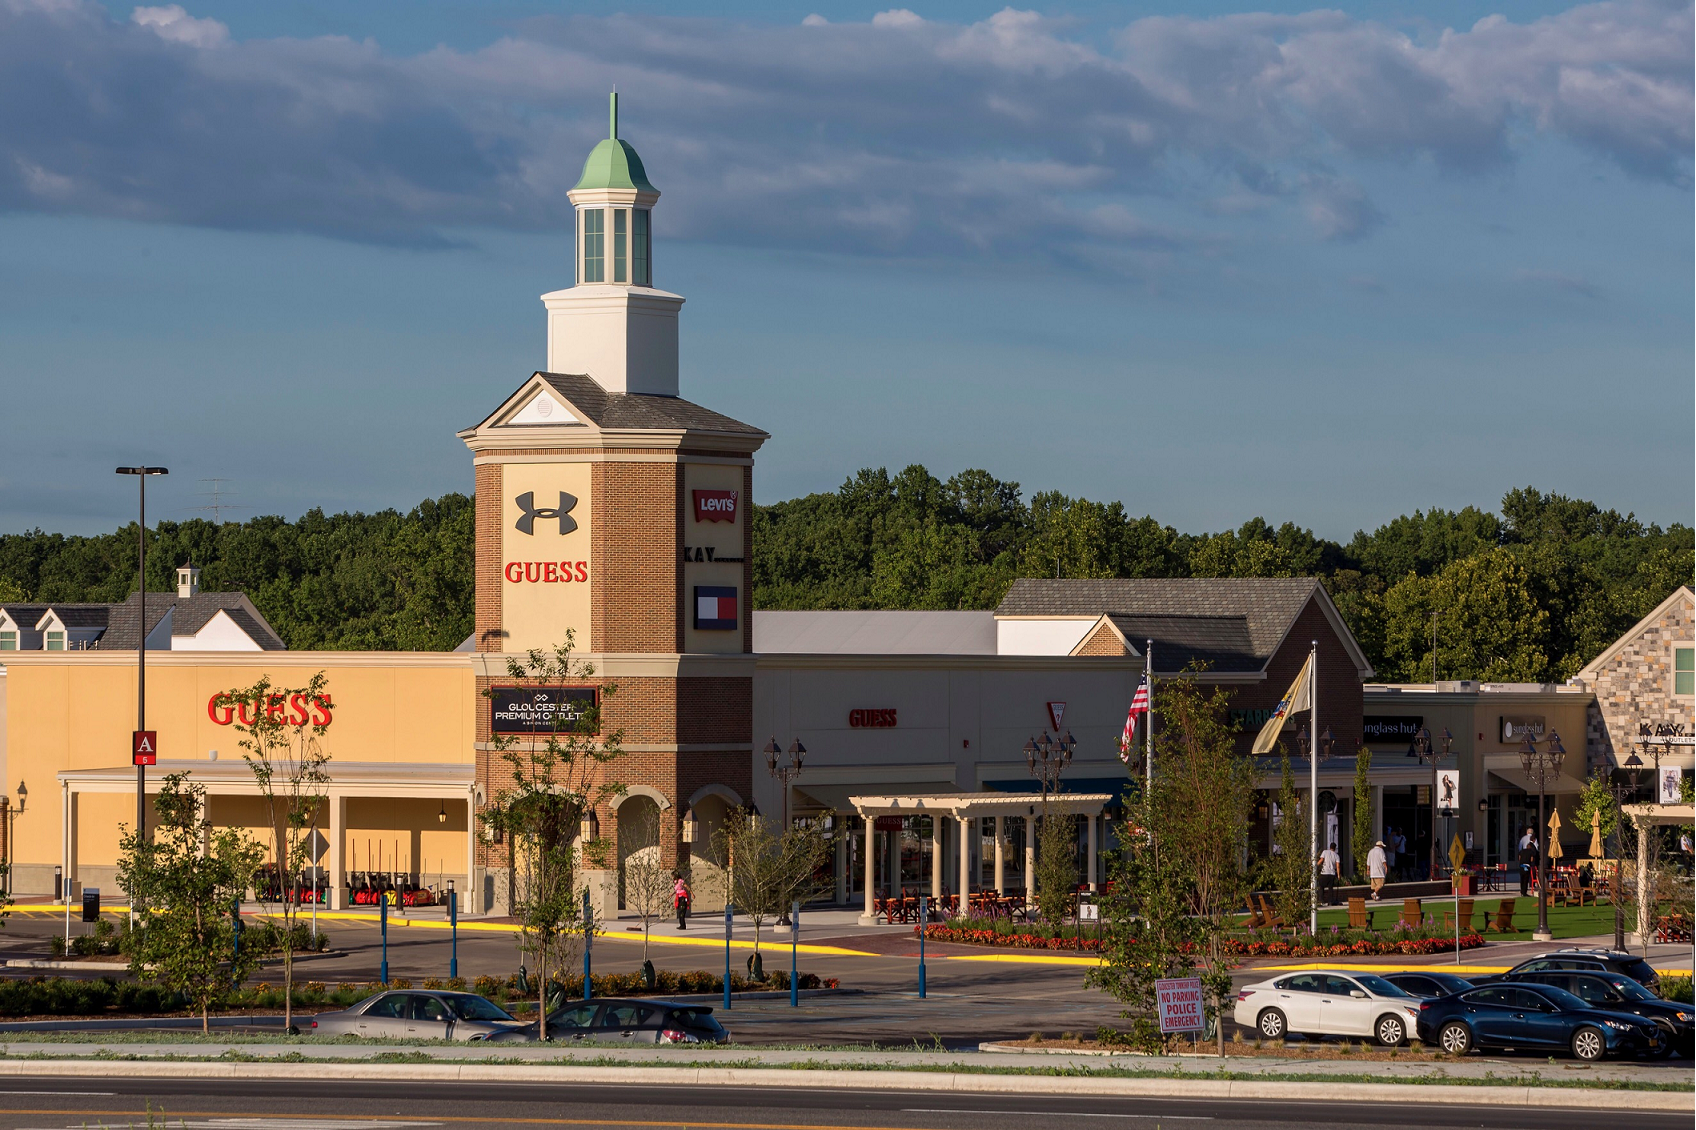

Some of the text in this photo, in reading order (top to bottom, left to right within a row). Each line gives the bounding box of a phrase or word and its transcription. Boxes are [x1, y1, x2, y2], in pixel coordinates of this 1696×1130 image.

[684, 547, 715, 562] KAY
[505, 561, 588, 583] GUESS
[207, 693, 332, 726] GUESS
[495, 712, 540, 720] PREMIUM
[849, 708, 898, 727] GUESS
[1400, 721, 1417, 734] hut
[137, 736, 153, 752] A
[1161, 991, 1199, 1003] NO PARKING
[1167, 1003, 1196, 1015] POLICE
[1165, 1015, 1200, 1027] EMERGENCY
